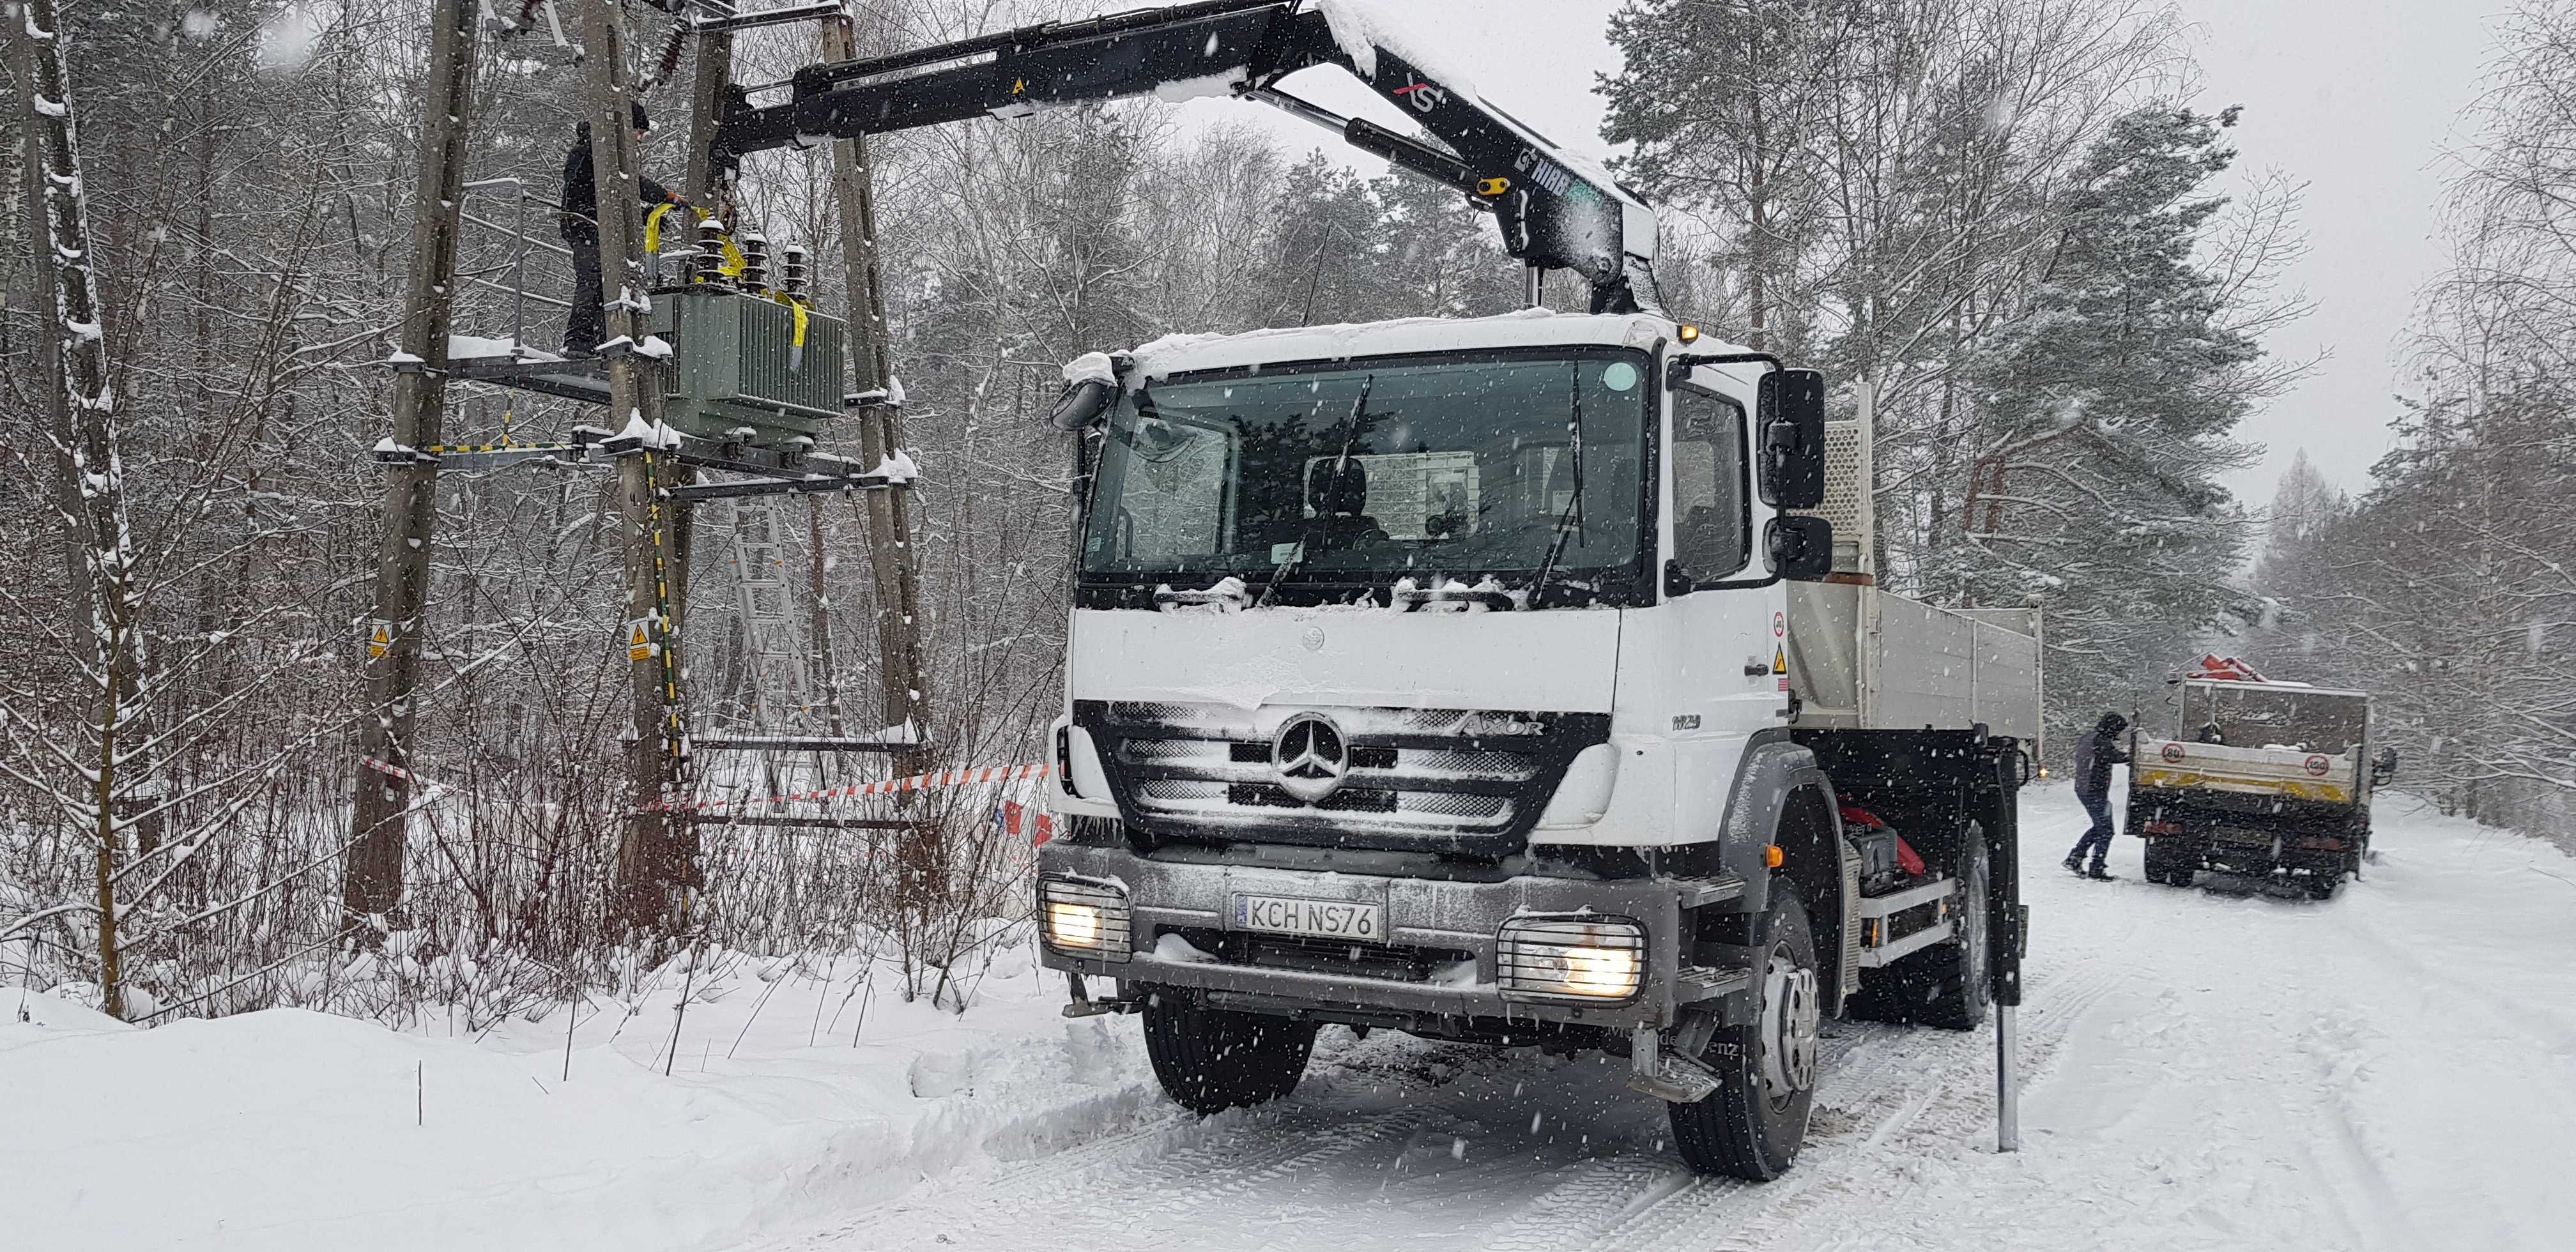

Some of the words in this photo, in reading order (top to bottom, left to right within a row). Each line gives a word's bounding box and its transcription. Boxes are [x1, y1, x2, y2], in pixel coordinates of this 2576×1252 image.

[1393, 72, 1440, 112] XS
[1531, 158, 1570, 196] HIAB
[1252, 899, 1298, 929] KCH
[1308, 903, 1371, 935] NS76
